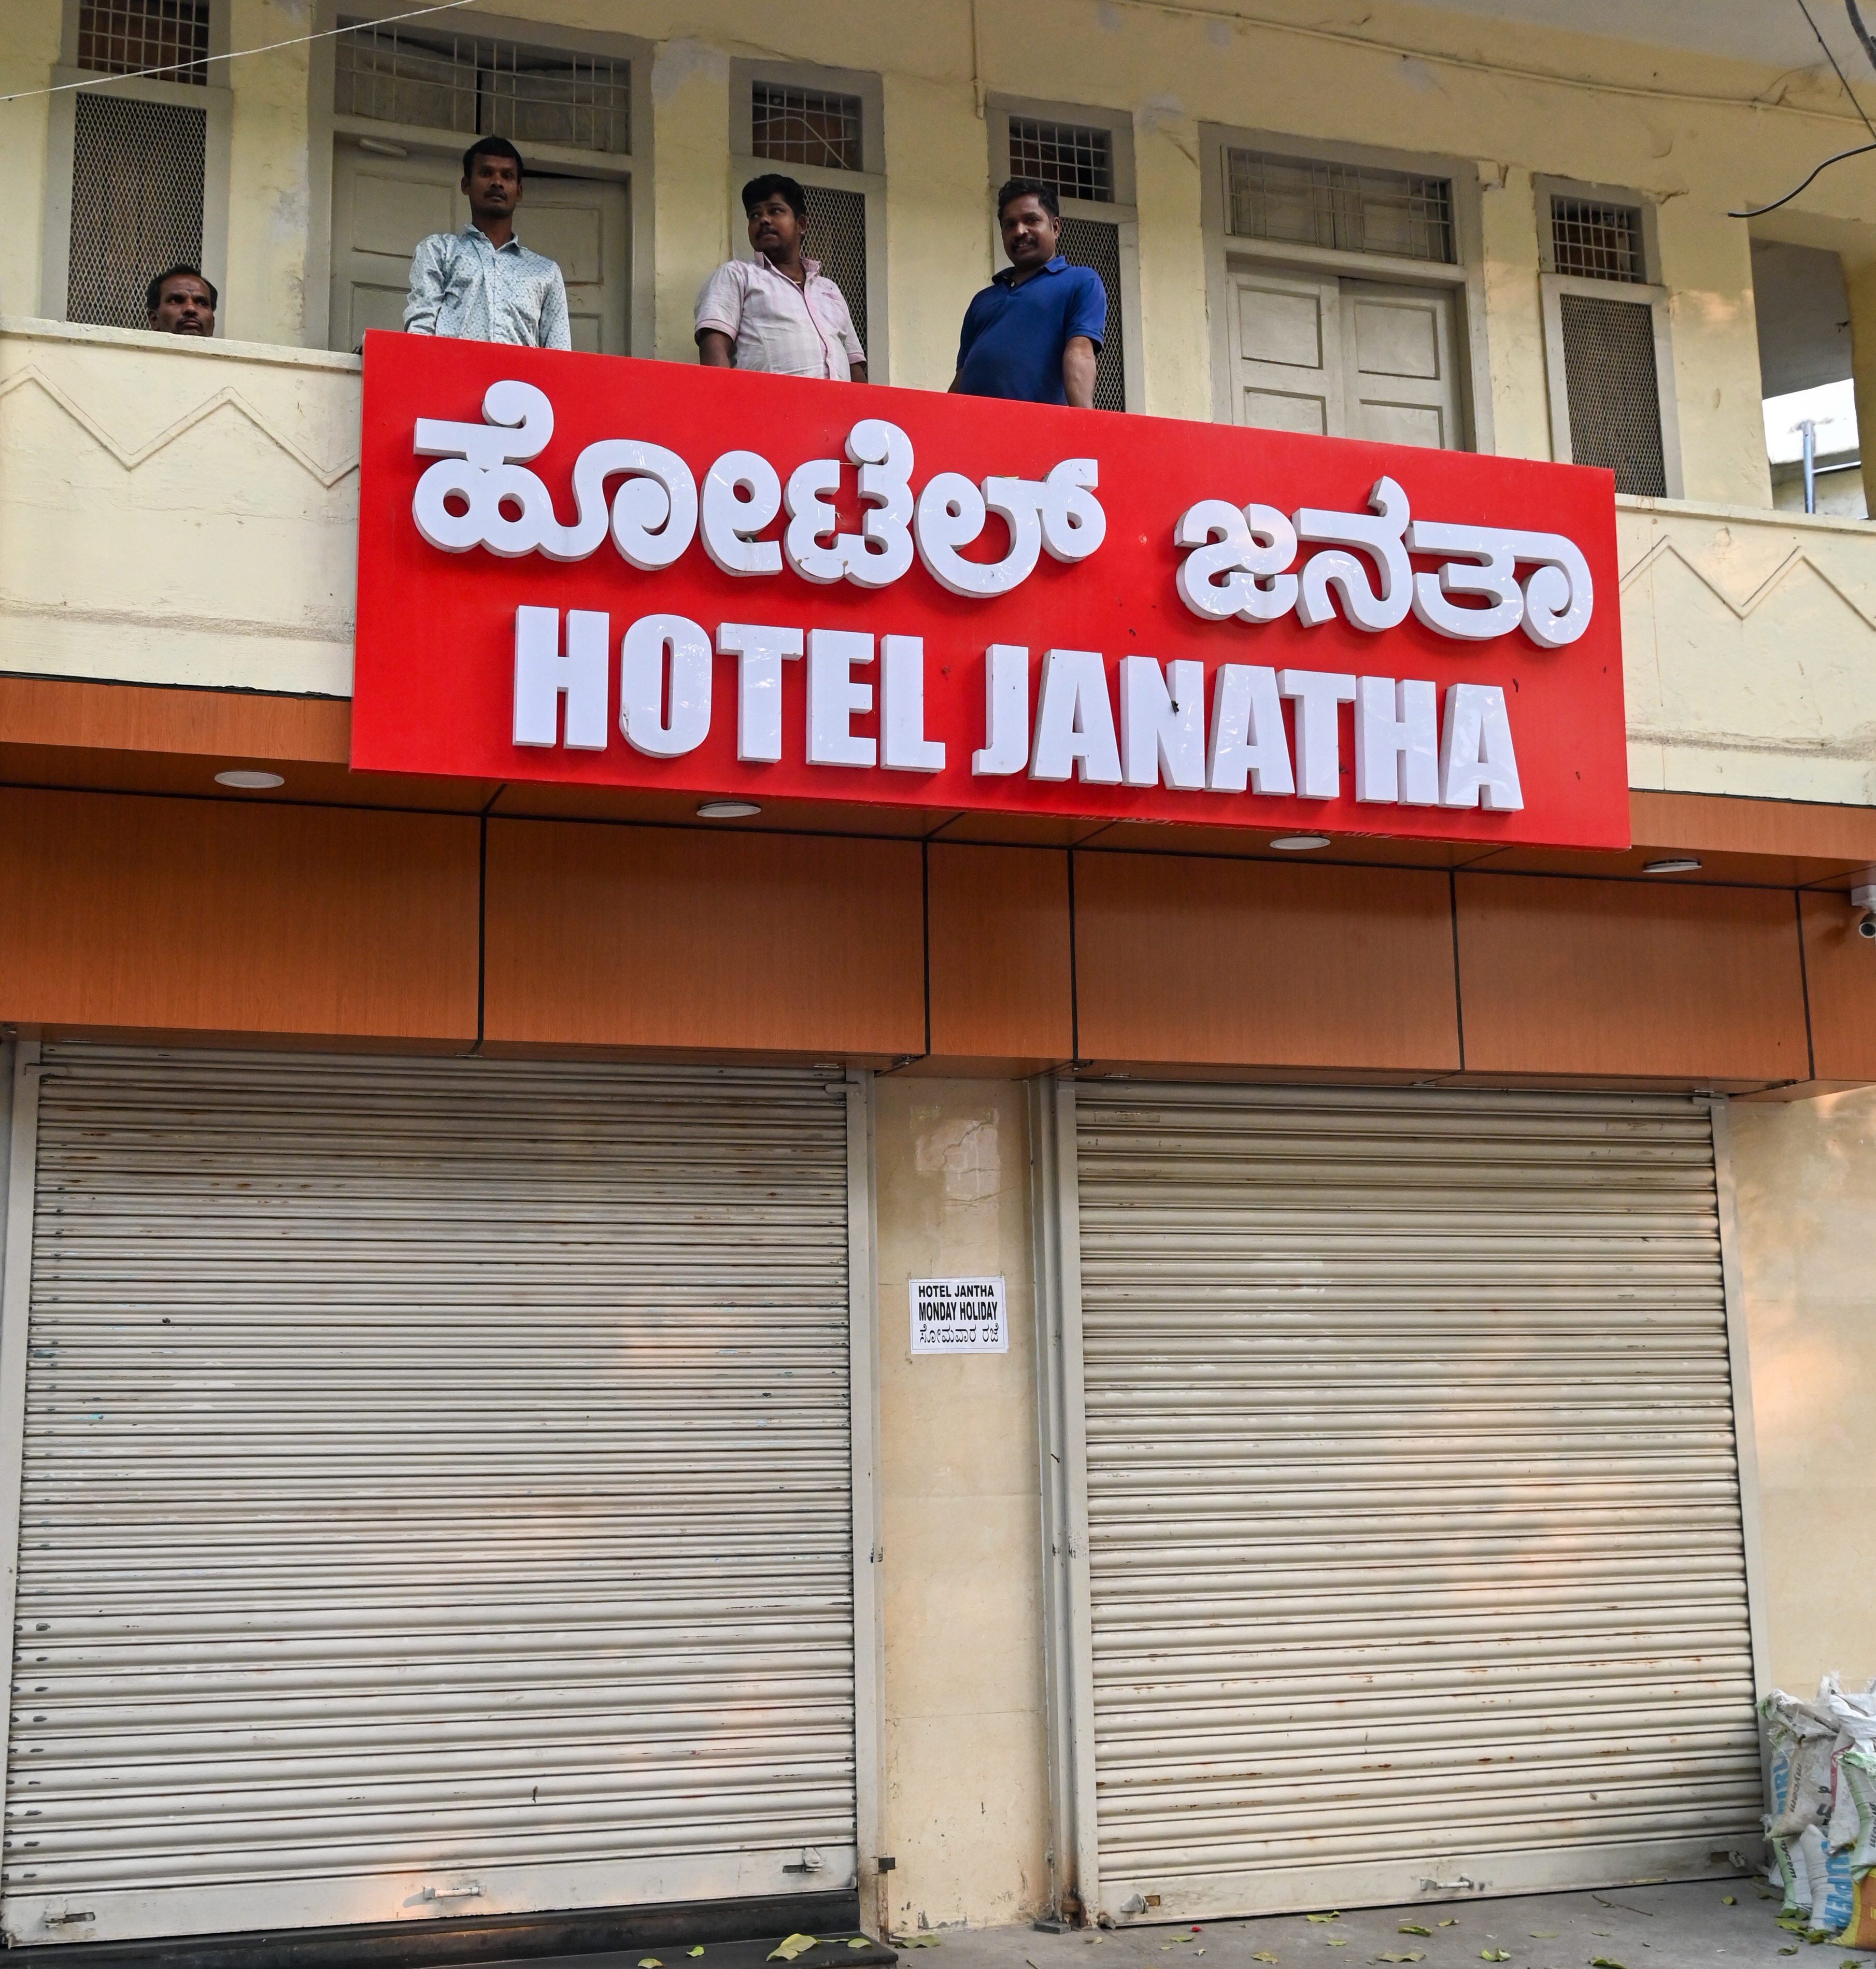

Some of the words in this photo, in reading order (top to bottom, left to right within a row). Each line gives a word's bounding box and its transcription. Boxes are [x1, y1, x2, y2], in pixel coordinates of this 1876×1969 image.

[412, 380, 1106, 598] ಹೋಟೆಲ್
[1174, 475, 1594, 648] ಜನತಾ
[513, 605, 945, 773] HOTEL
[972, 644, 1524, 812] JANATHA
[918, 1285, 952, 1297] HOTEL
[954, 1285, 994, 1297] JANTHA
[919, 1301, 957, 1321] MONDAY
[960, 1301, 998, 1320] HOLIDAY
[919, 1324, 976, 1343] ಸೋಮವಾರ
[982, 1323, 999, 1342] ರಜೆ
